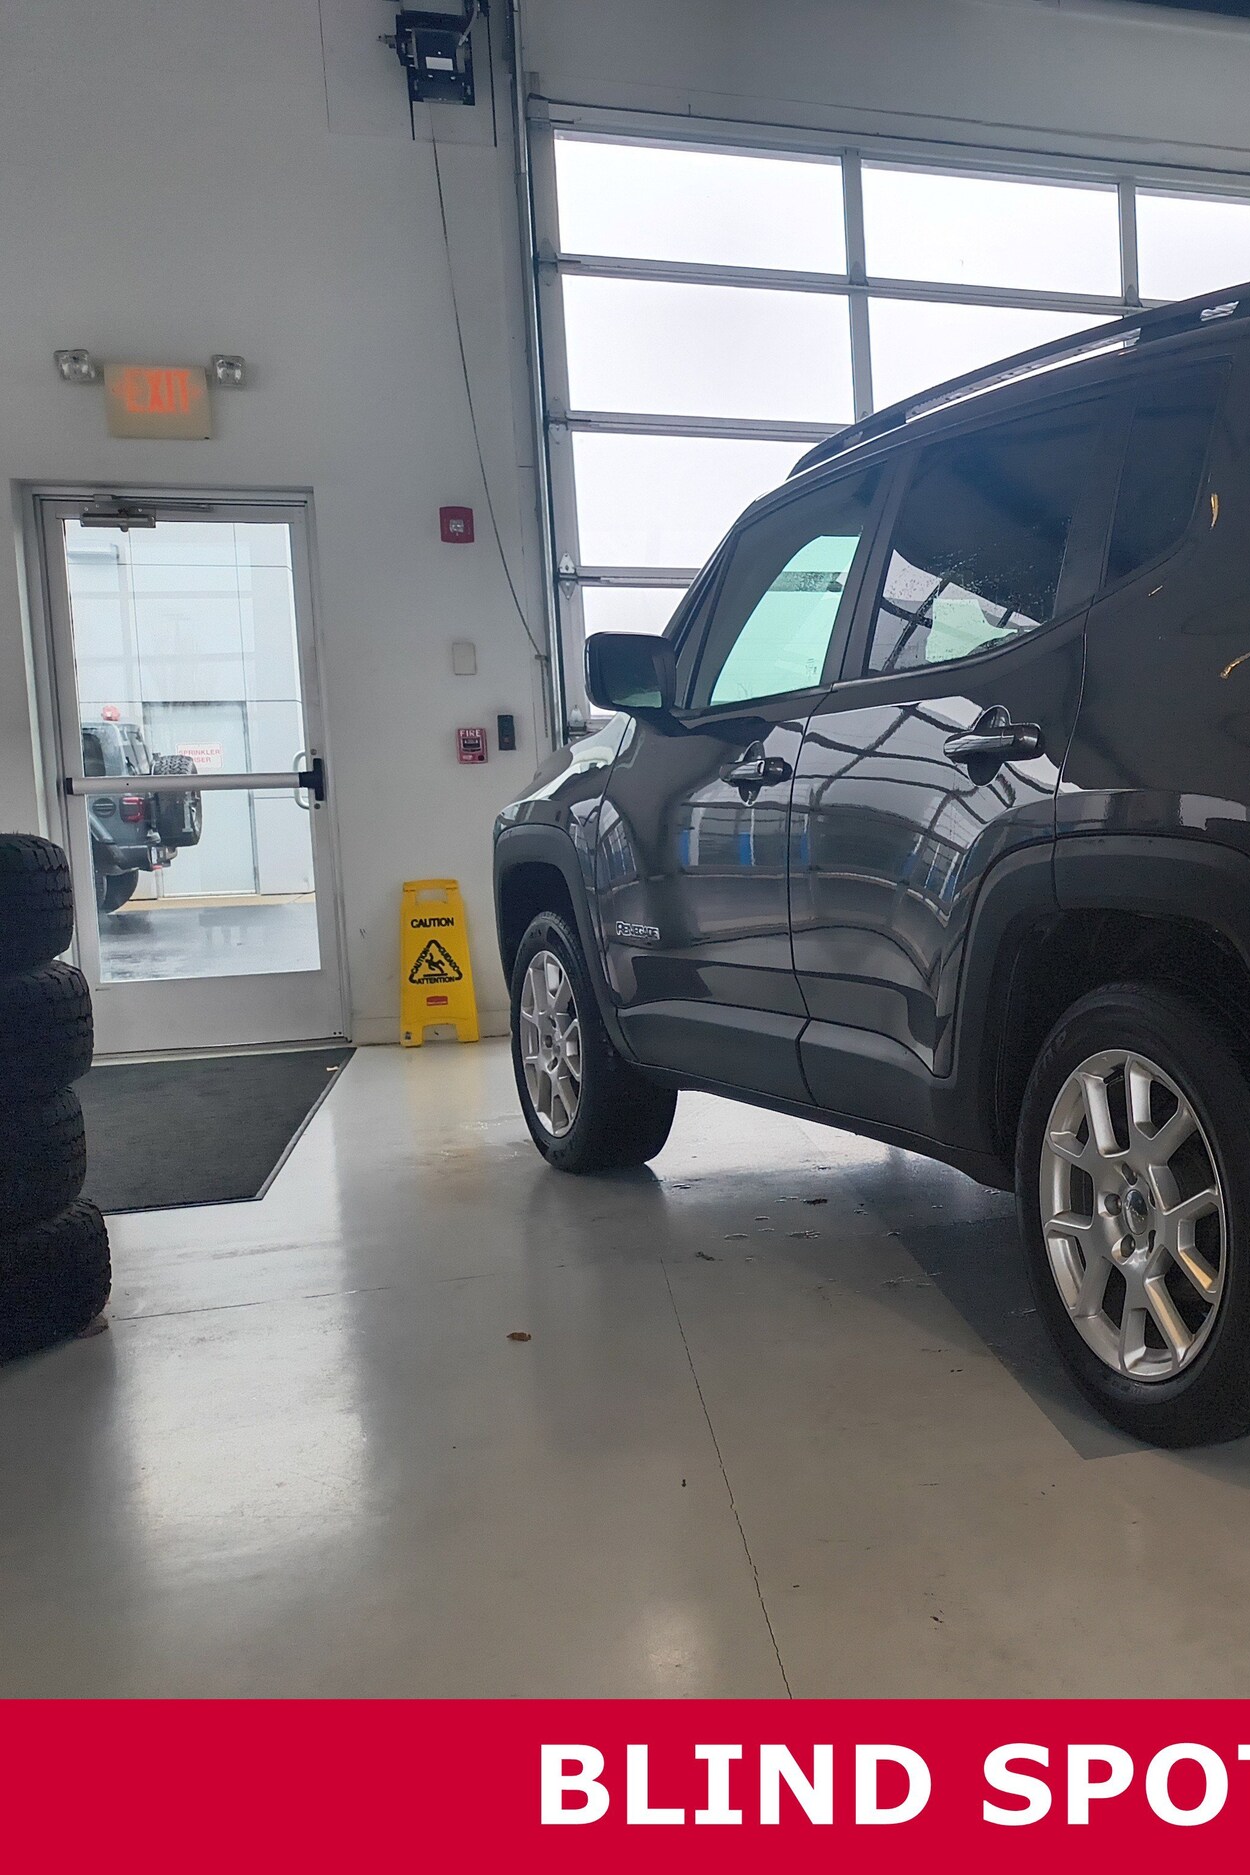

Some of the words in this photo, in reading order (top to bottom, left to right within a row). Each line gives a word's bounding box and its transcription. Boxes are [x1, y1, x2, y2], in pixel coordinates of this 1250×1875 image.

[124, 367, 190, 413] EXIT
[460, 729, 481, 737] FIRE
[410, 917, 455, 928] CAUTION
[410, 947, 430, 974] CAUTION
[416, 976, 456, 985] ATTENTION
